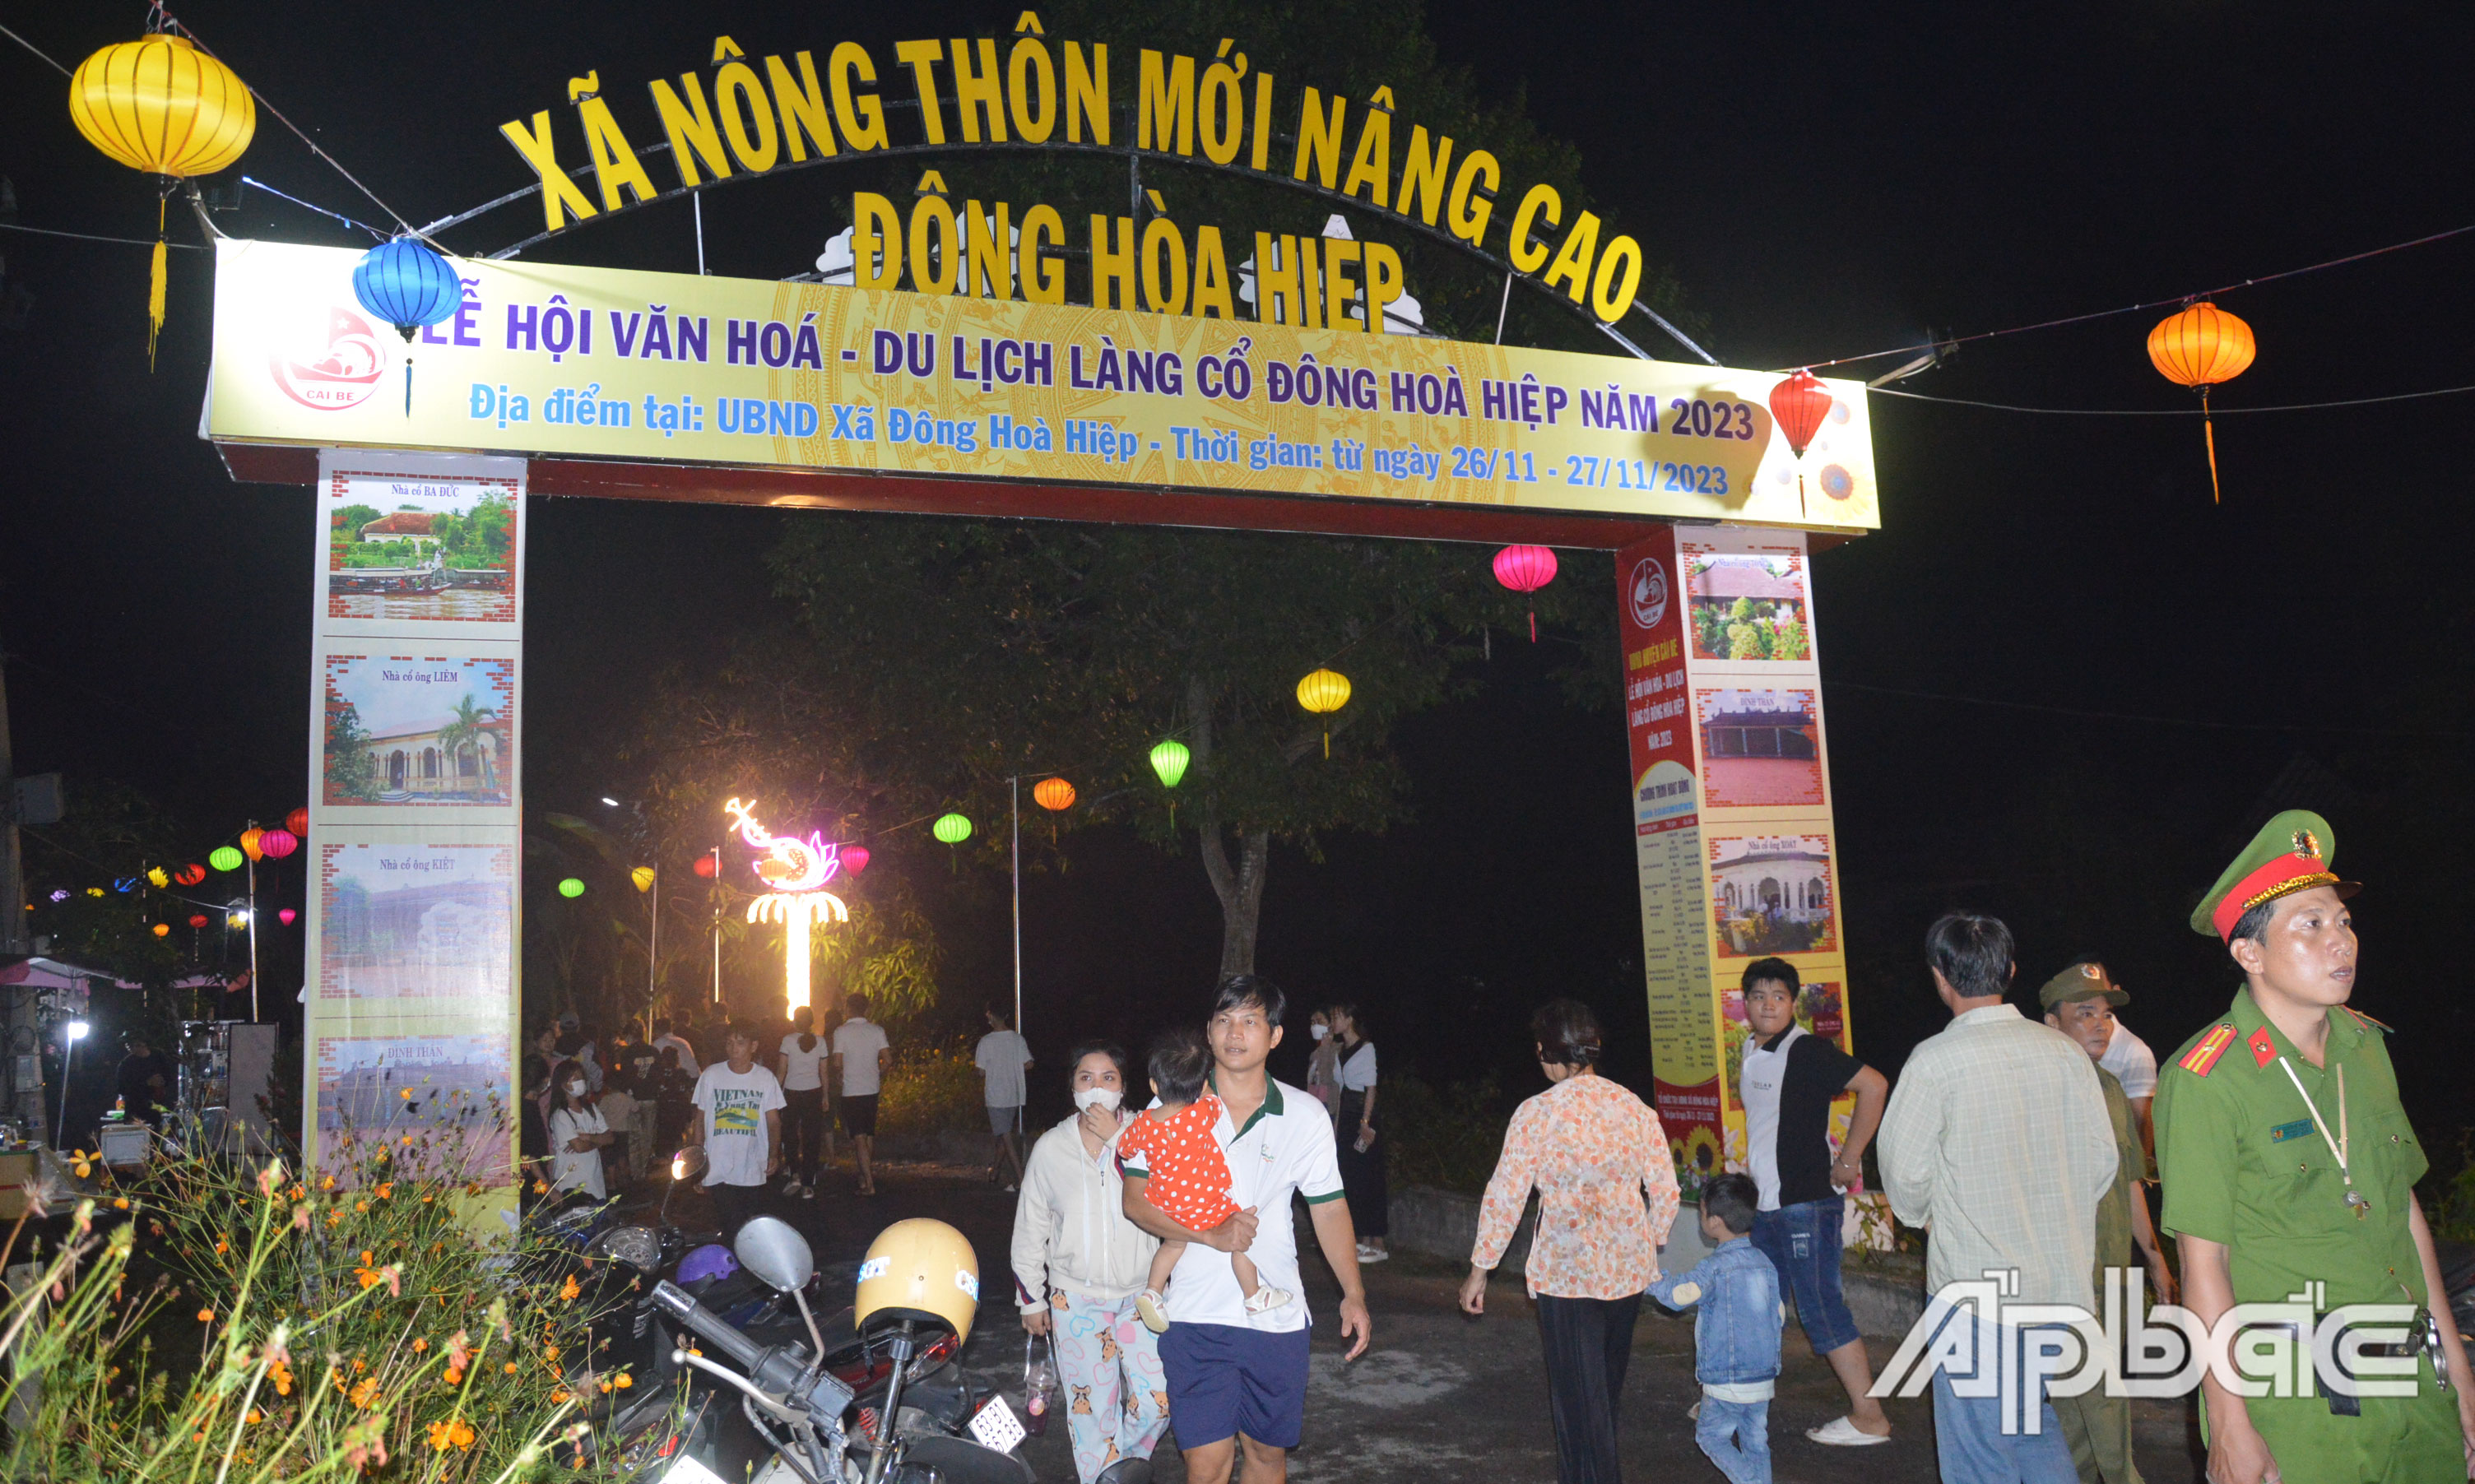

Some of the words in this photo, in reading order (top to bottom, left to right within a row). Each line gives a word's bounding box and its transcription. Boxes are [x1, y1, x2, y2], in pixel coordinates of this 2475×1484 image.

[499, 70, 657, 233] XÃ
[650, 35, 889, 188] NÔNG
[895, 11, 1110, 146] THÔN
[1138, 38, 1273, 172] MỚI
[1293, 85, 1501, 248] NÂNG
[1509, 183, 1643, 324] CAO
[851, 169, 1066, 309] ĐÔNG
[1090, 189, 1236, 322] HÒA
[506, 294, 592, 363] HỘI
[610, 304, 708, 362] VĂN
[727, 313, 823, 369] HOÁ
[842, 350, 857, 360] -
[875, 330, 935, 378] DU
[954, 336, 1052, 392] LỊCH
[1070, 336, 1182, 396] LÀNG
[1196, 336, 1251, 401] CỔ
[1266, 353, 1377, 410] ĐÔNG
[1391, 365, 1468, 417] HOÀ
[1482, 373, 1567, 433] HIỆP
[1581, 384, 1658, 433] NĂM
[1671, 397, 1754, 440] 2023
[469, 383, 529, 429] Địa
[544, 382, 631, 428] điểm
[643, 394, 703, 438] tại:
[717, 397, 819, 438] UBND
[830, 404, 875, 441] Xã
[888, 407, 977, 453] Đông
[990, 414, 1052, 452] Hoà
[1066, 420, 1138, 463] Hiệp
[1149, 442, 1161, 450] -
[1169, 426, 1238, 463] Thời
[1250, 434, 1322, 471] gian:
[1331, 439, 1365, 471] từ
[1373, 448, 1441, 481] ngày
[1451, 446, 1538, 482] 26/11
[392, 484, 409, 495] Nhà
[411, 484, 422, 496] cổ
[425, 486, 437, 497] BA
[439, 484, 460, 498] ĐỨC
[382, 670, 400, 681] Nhà
[402, 669, 413, 681] cổ
[416, 671, 431, 684] ông
[434, 669, 458, 682] LIÊM
[380, 859, 397, 870] Nhà
[413, 859, 430, 873] ông
[714, 1088, 764, 1102] VIETNAM
